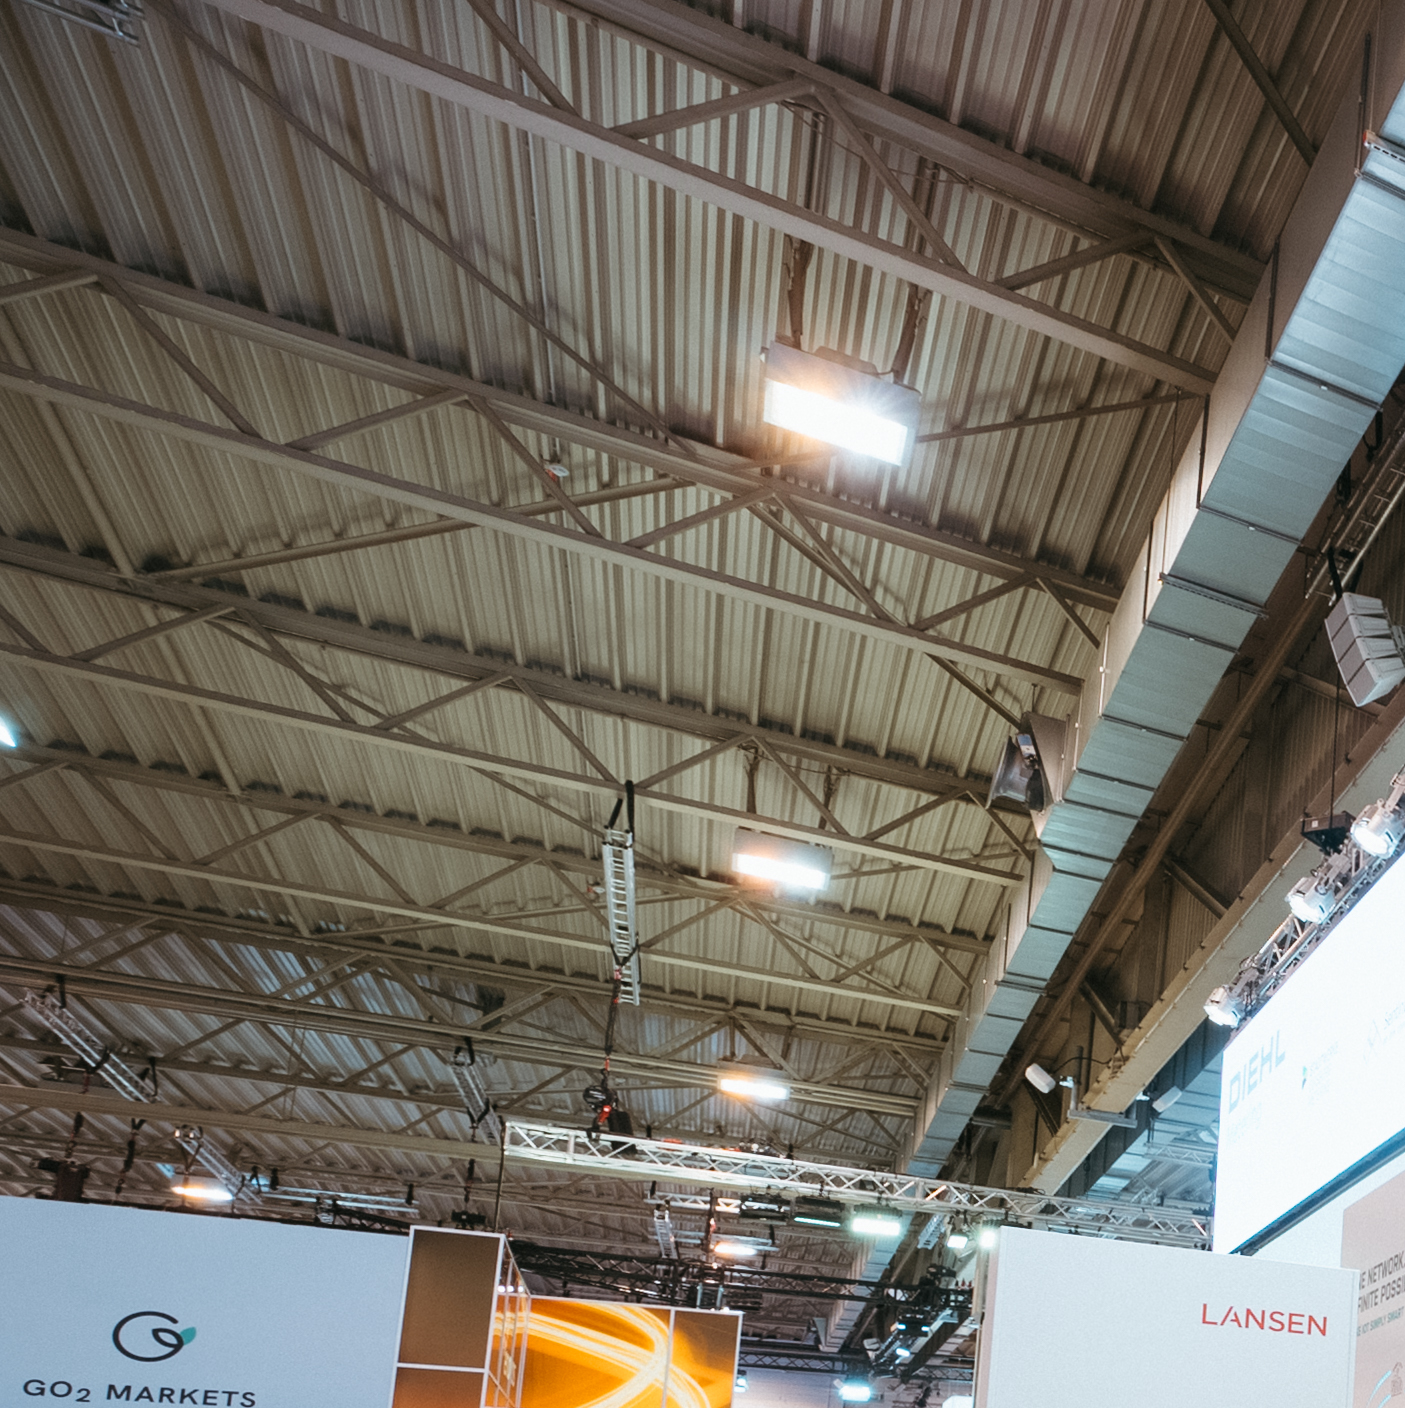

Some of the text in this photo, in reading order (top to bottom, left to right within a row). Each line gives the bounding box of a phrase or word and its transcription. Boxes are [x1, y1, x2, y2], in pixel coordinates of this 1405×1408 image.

[1228, 1029, 1286, 1115] DIEHL
[1201, 1303, 1327, 1337] LANSEN
[22, 1379, 257, 1408] GO2 MARKETS
